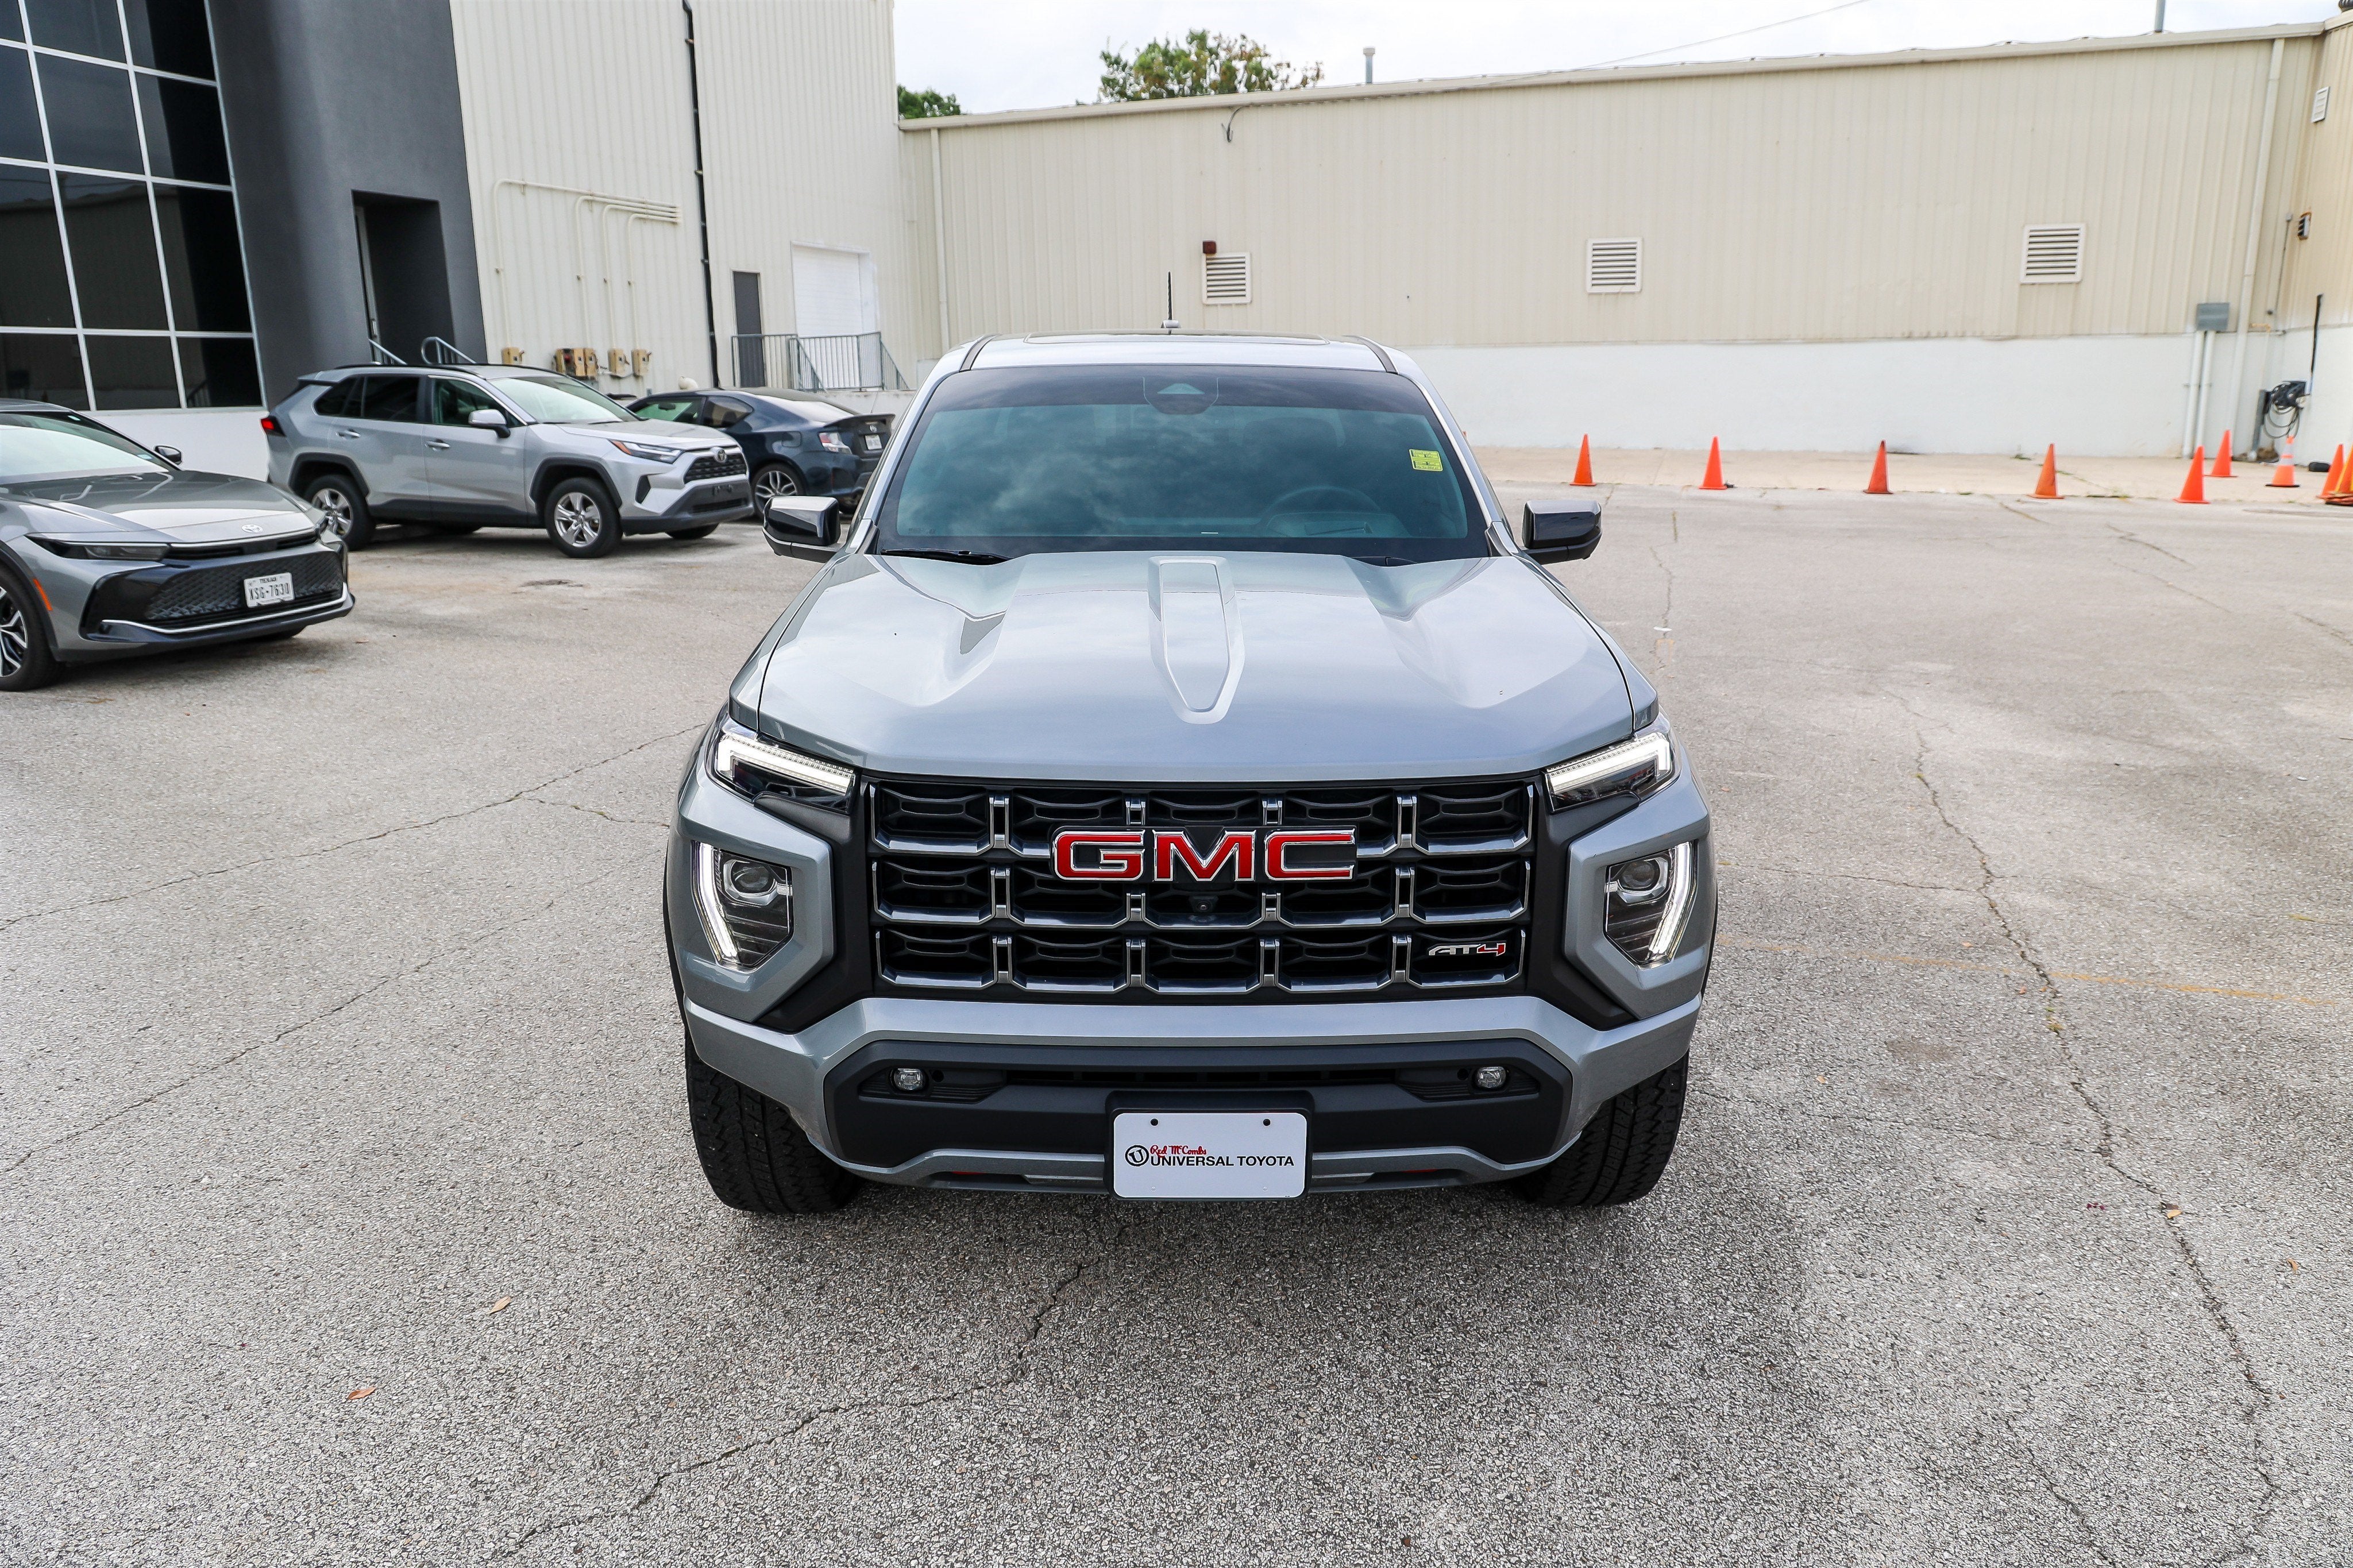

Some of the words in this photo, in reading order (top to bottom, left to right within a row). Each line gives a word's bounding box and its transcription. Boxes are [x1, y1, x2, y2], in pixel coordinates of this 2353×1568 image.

[1052, 829, 1356, 882] GMC
[1429, 943, 1506, 956] AT4
[1150, 1145, 1167, 1158] Red
[1168, 1145, 1207, 1155] McCombs
[1151, 1156, 1233, 1167] UNIVERSAL
[1237, 1156, 1294, 1167] TOYOTA
